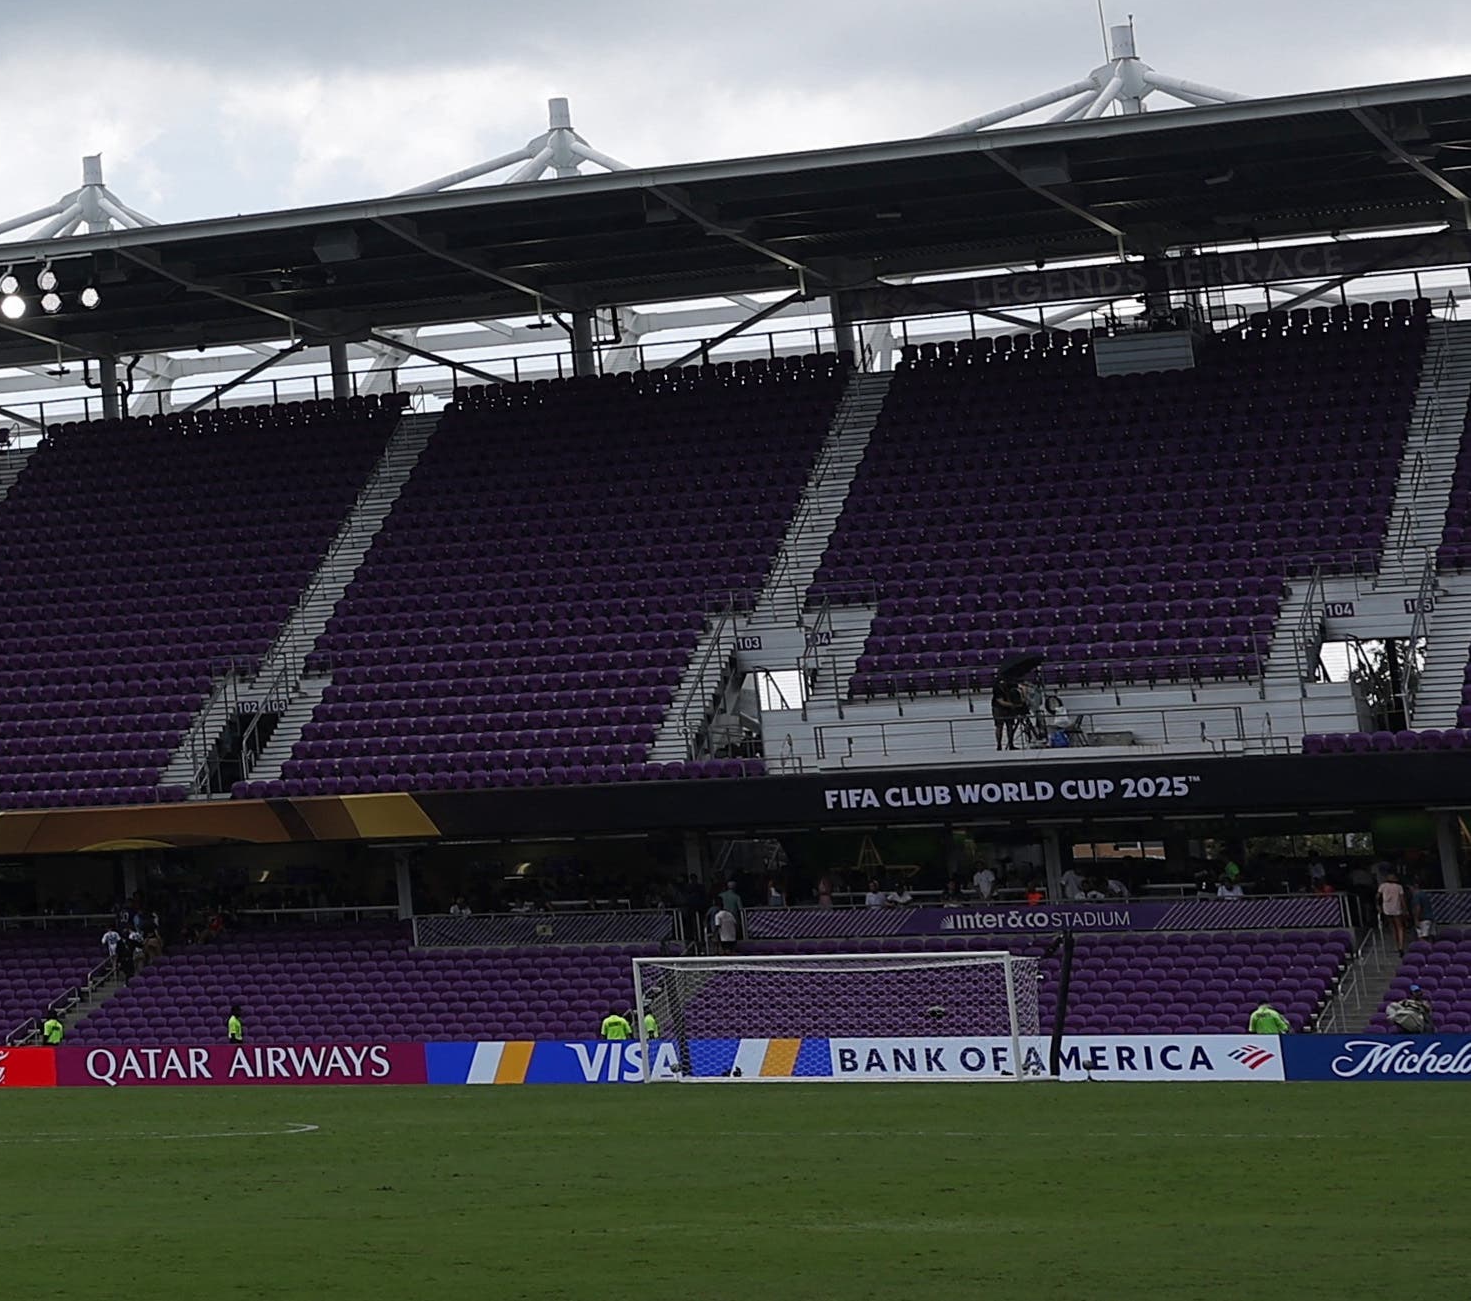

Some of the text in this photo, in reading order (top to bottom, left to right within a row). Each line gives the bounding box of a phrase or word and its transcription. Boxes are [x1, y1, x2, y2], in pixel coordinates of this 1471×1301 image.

[971, 248, 1346, 306] LEGENDS TERRACE
[1326, 603, 1353, 617] 104
[737, 637, 761, 650] 103
[237, 701, 259, 713] 102
[824, 788, 881, 810] FIFA
[884, 785, 952, 808] CLUB
[955, 780, 1055, 804] WORLD
[1060, 777, 1115, 801] CUP
[1051, 910, 1132, 928] STADIUM
[85, 1045, 391, 1087] QATAR AIRWAYS
[838, 1044, 1215, 1073] BANK OF AMERICA
